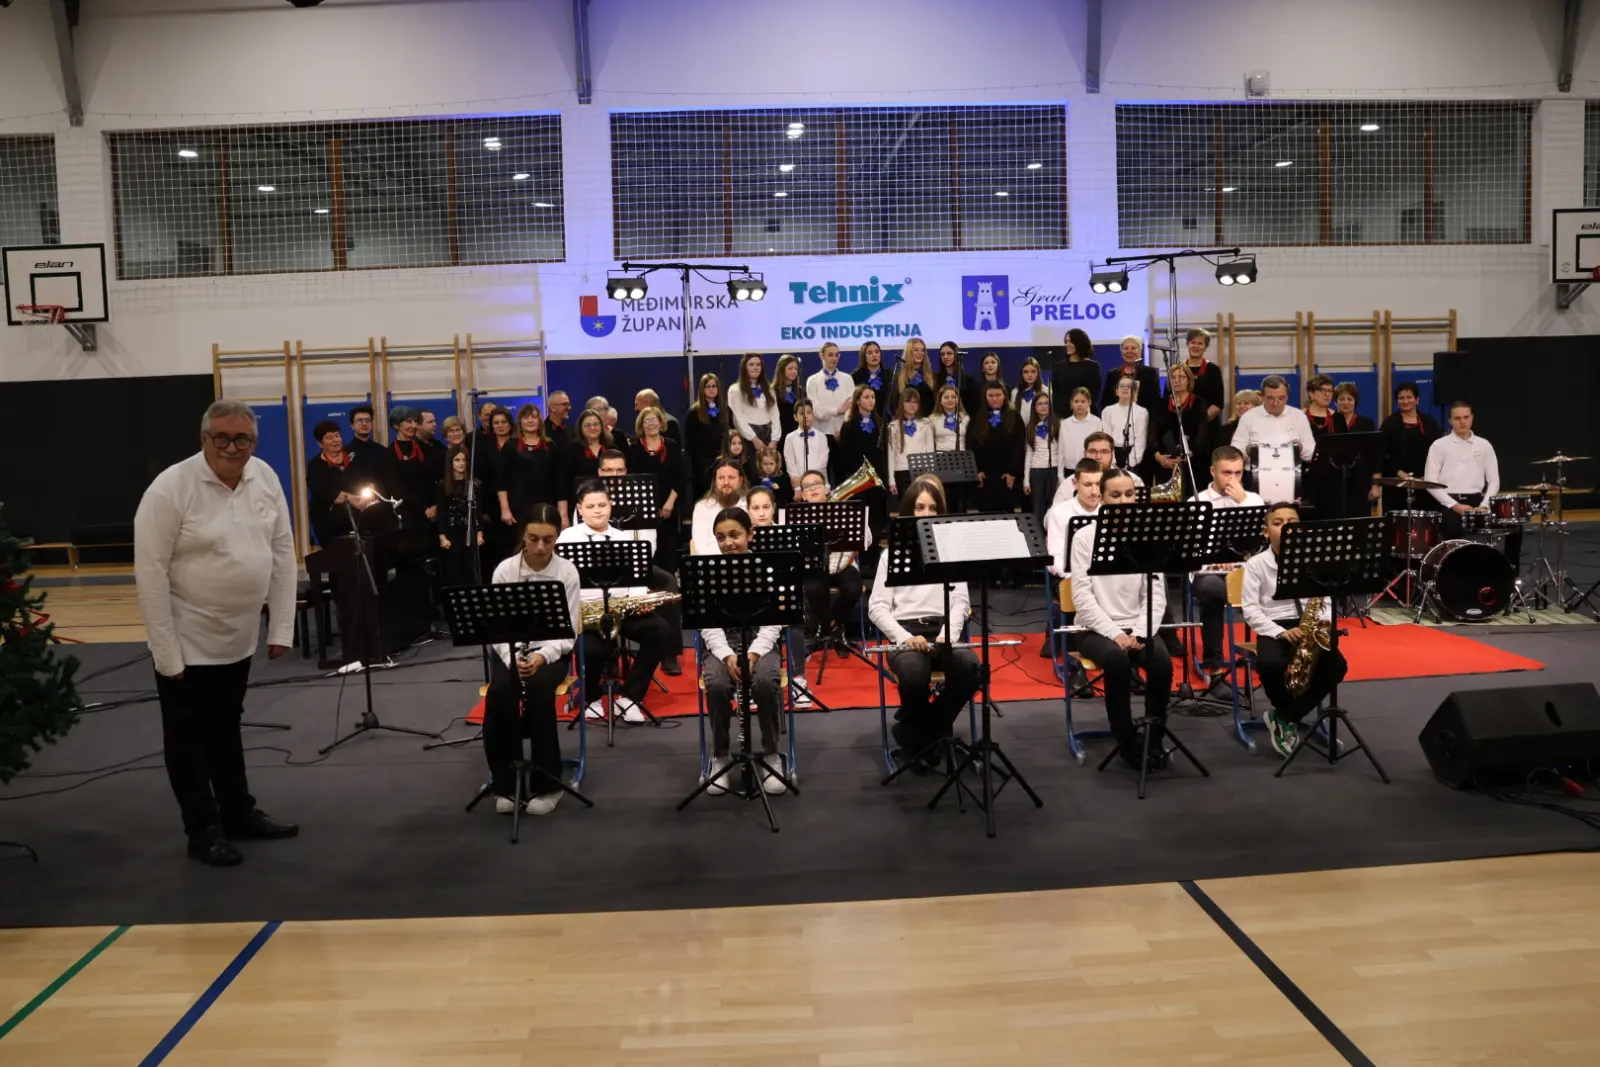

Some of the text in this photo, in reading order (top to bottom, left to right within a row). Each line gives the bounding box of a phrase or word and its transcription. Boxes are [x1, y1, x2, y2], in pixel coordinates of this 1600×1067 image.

[34, 260, 73, 268] elan
[789, 275, 905, 304] Tehnix
[1012, 285, 1073, 307] Grad
[1030, 303, 1116, 321] PRELOG
[781, 323, 922, 340] EKO INDUSTRIJA
